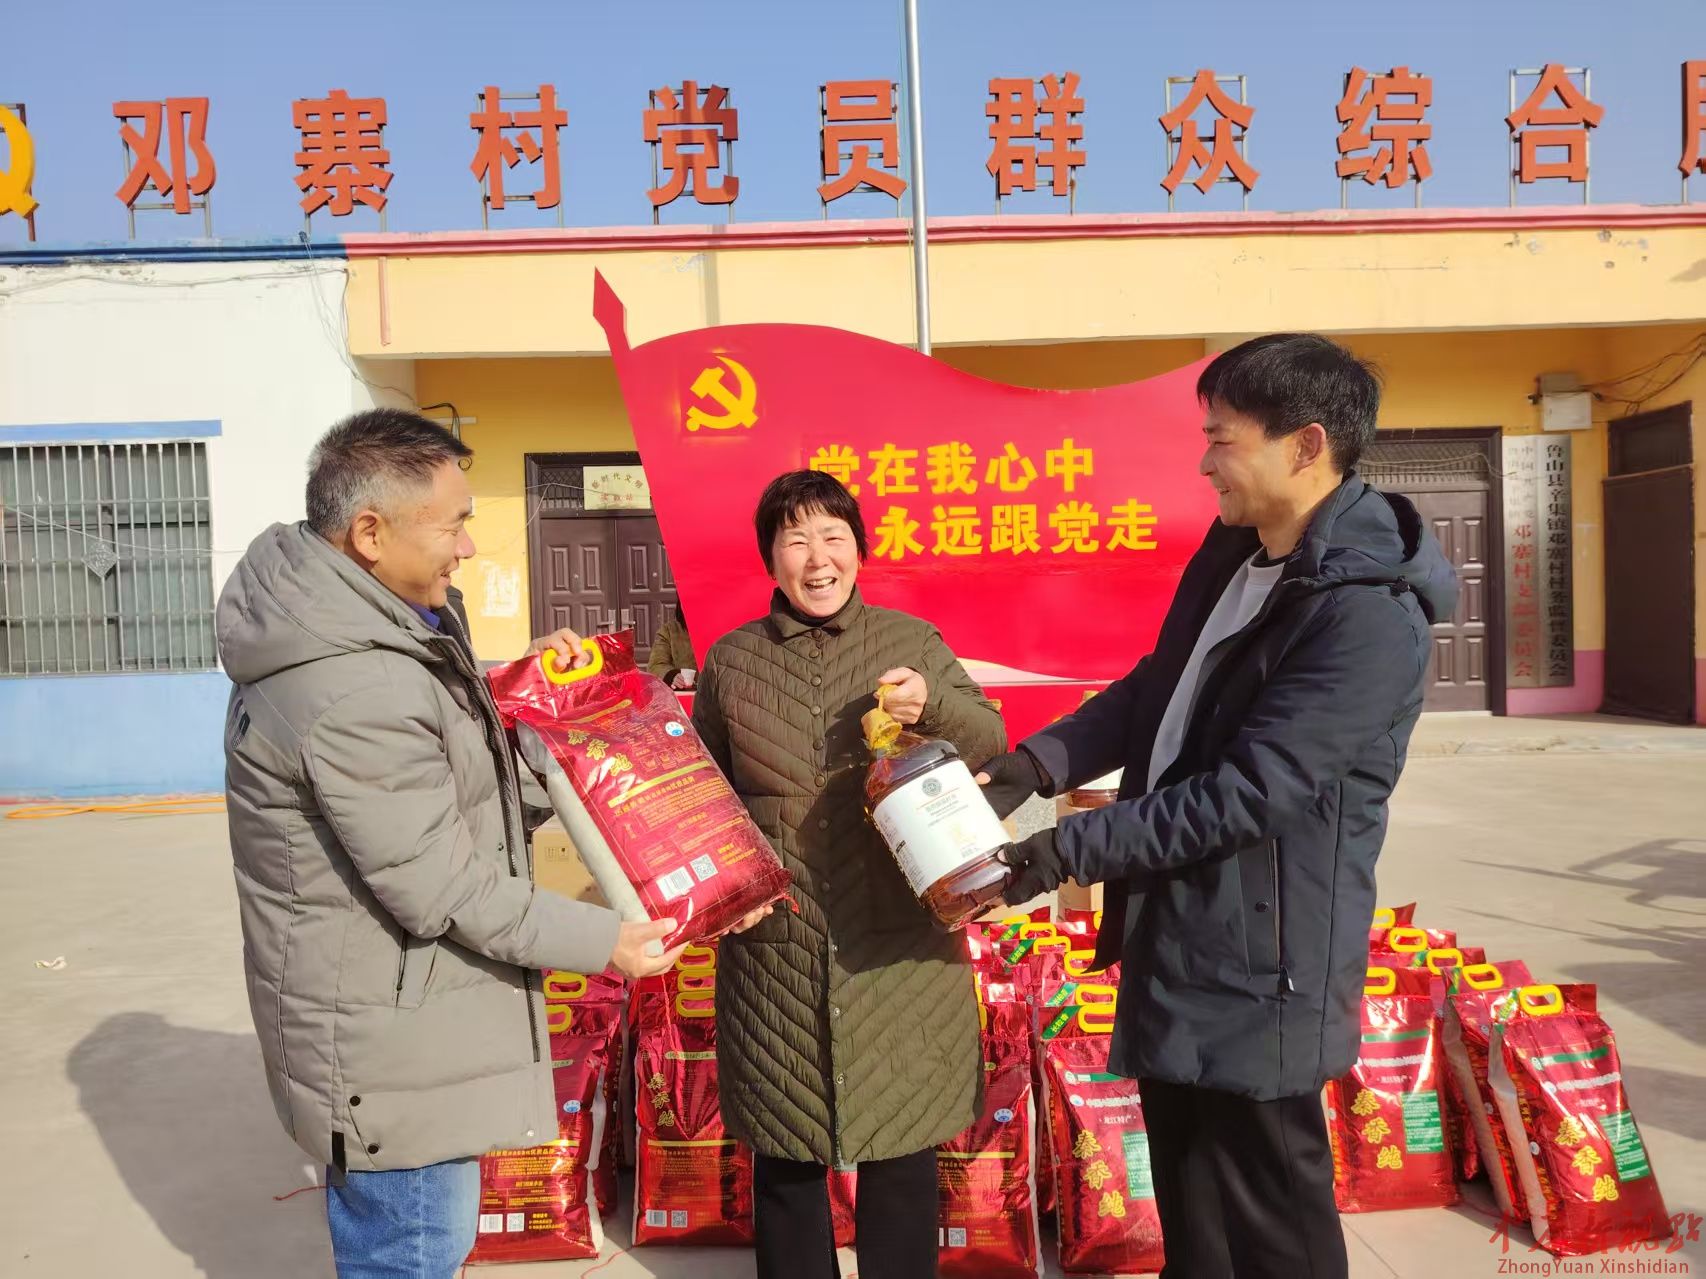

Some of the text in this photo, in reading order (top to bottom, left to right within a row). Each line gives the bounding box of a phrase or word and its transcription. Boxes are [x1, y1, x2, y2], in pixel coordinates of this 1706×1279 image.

[112, 61, 1706, 217] 邓寨村党员群众综合
[809, 438, 1094, 498] 党在我心中
[873, 498, 1158, 560] 永远跟党走
